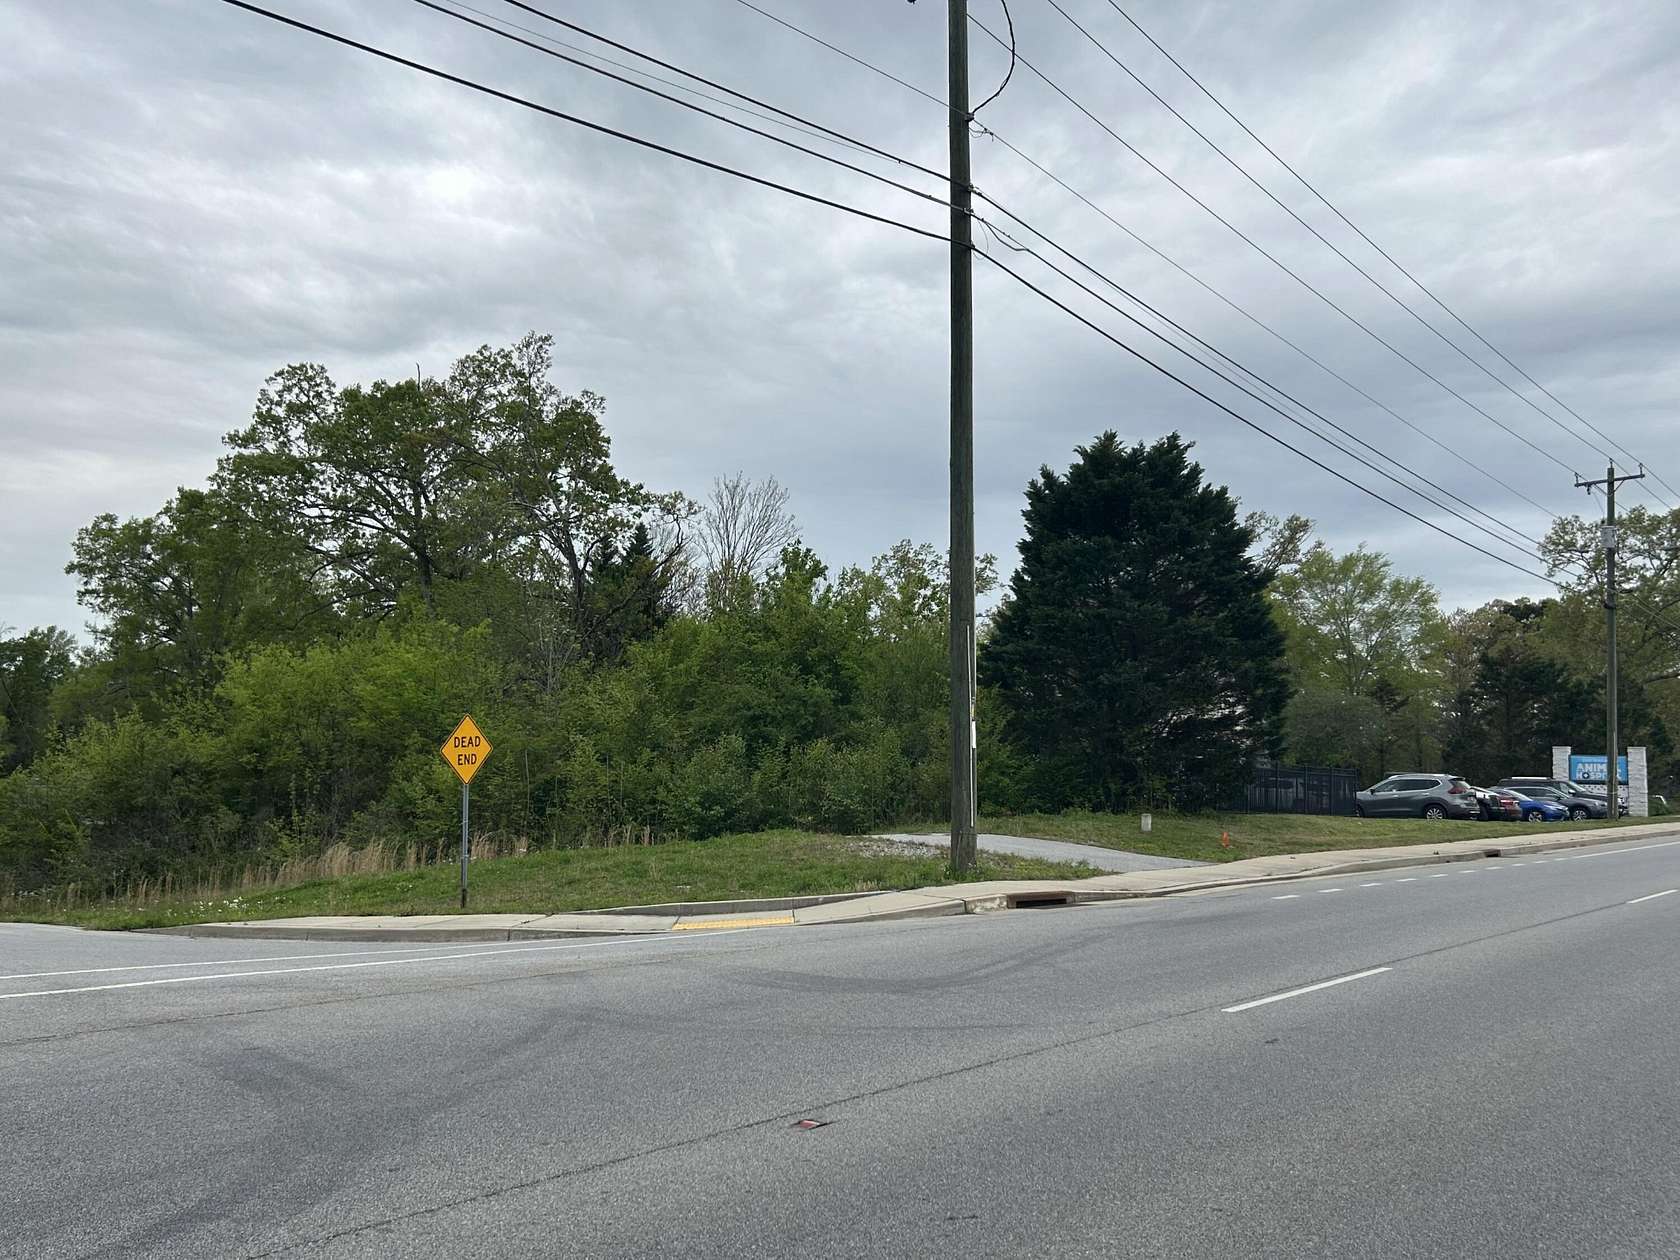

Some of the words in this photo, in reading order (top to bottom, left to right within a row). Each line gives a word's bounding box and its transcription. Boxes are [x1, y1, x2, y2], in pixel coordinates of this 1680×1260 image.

[453, 735, 481, 748] DEAD
[457, 753, 477, 766] END
[1576, 763, 1621, 772] ANIM
[1576, 772, 1621, 780] HOSPI
